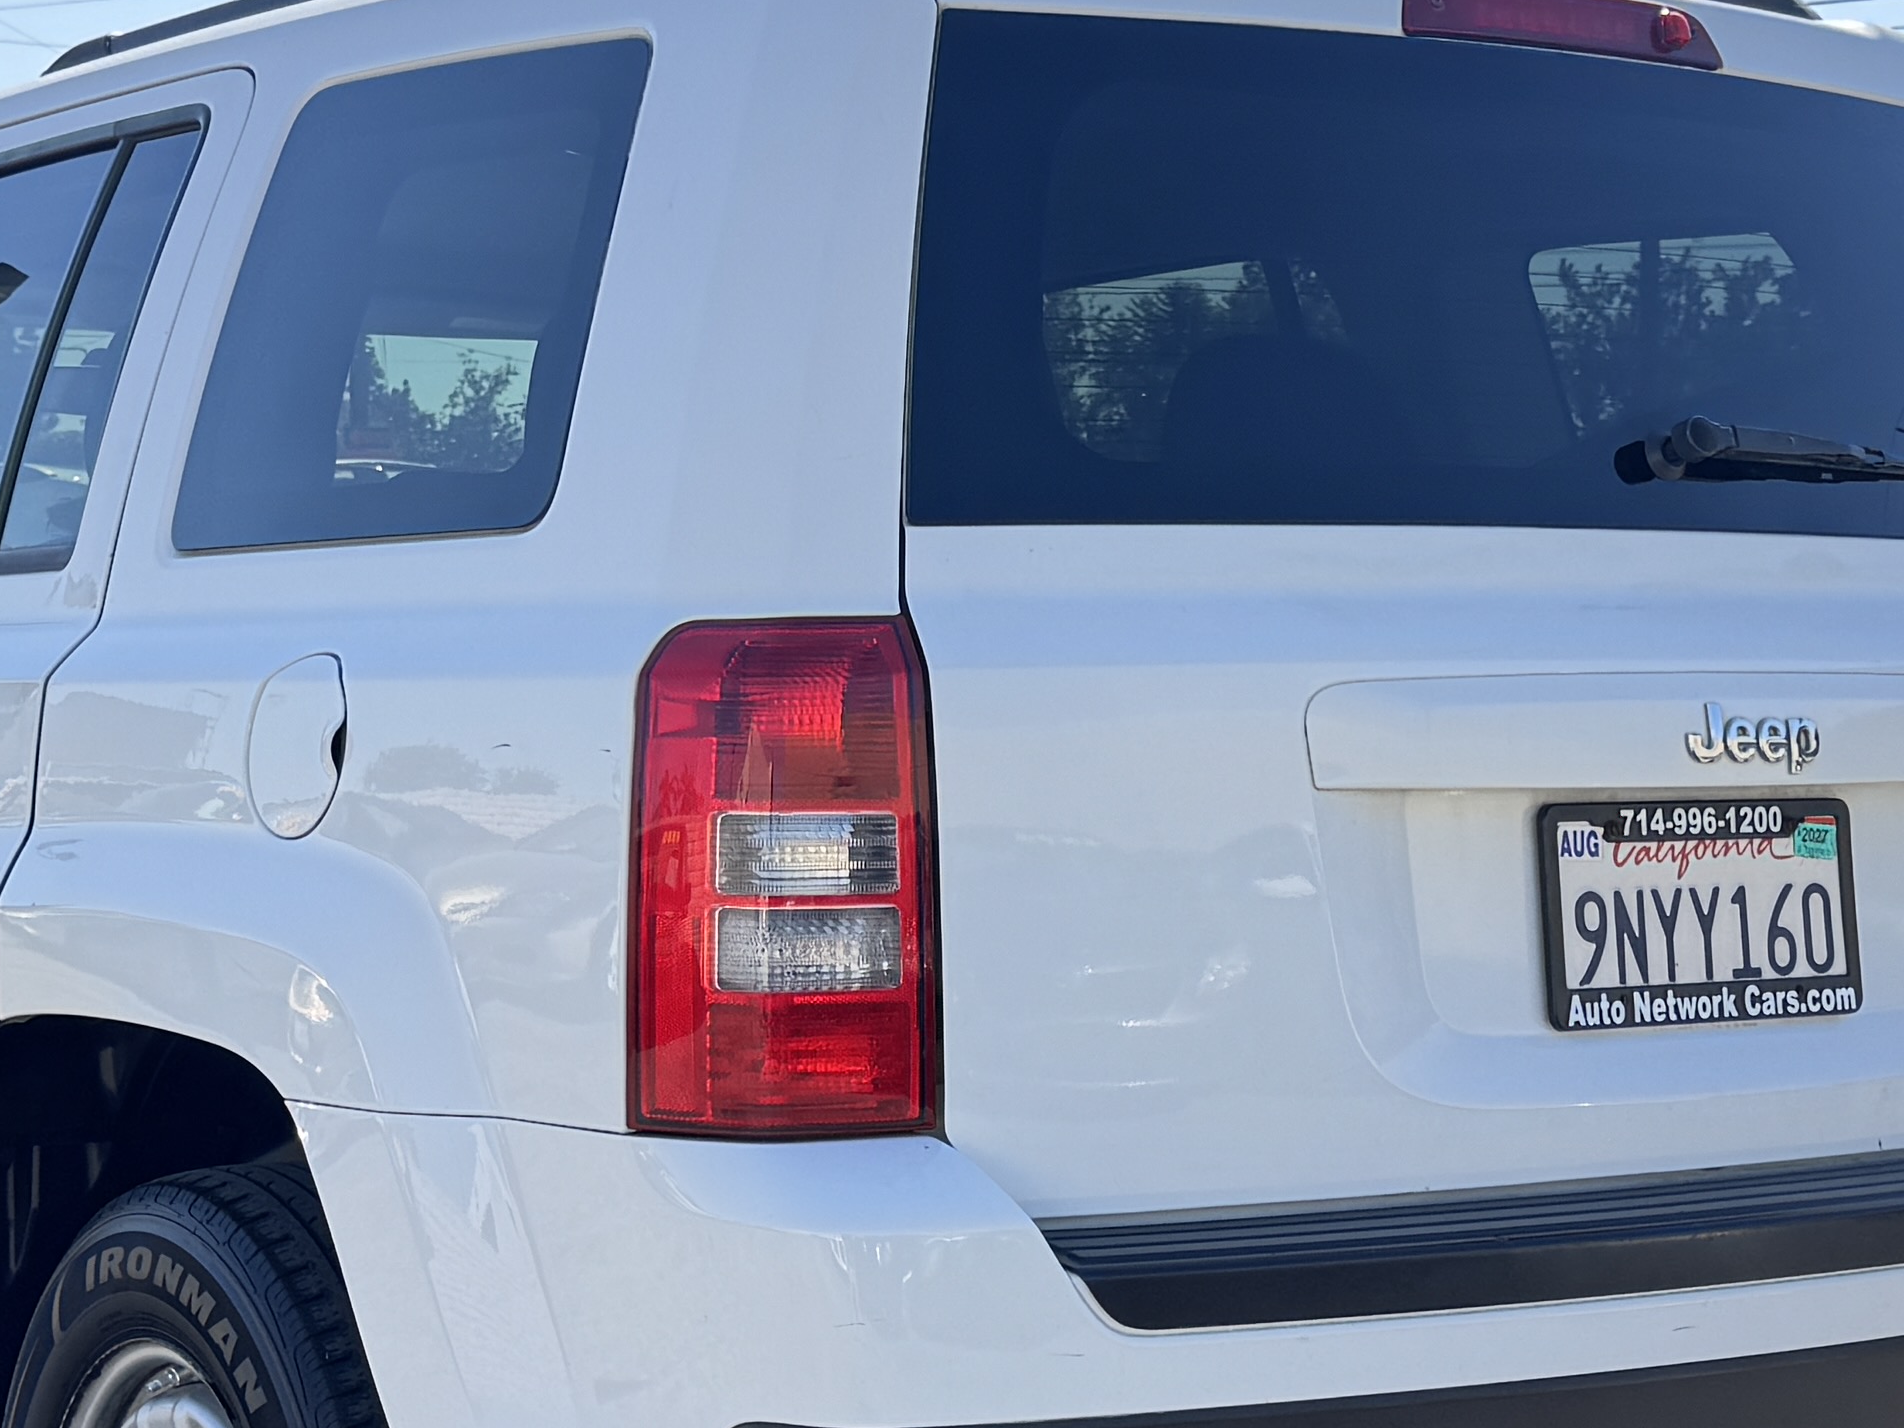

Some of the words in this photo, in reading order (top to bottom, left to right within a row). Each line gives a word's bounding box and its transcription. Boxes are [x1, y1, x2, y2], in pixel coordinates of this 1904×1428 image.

[1685, 701, 1821, 774] Jeep
[1619, 806, 1783, 836] 714-996-1200
[1560, 829, 1600, 857] AUG
[1612, 838, 1795, 880] California
[1801, 827, 1829, 843] 2027
[1574, 882, 1835, 986] 9NYY160
[1568, 994, 1625, 1027] Auto
[1633, 985, 1738, 1024] Network
[1744, 984, 1857, 1015] Cars.com
[85, 1245, 268, 1415] IRONMAN
